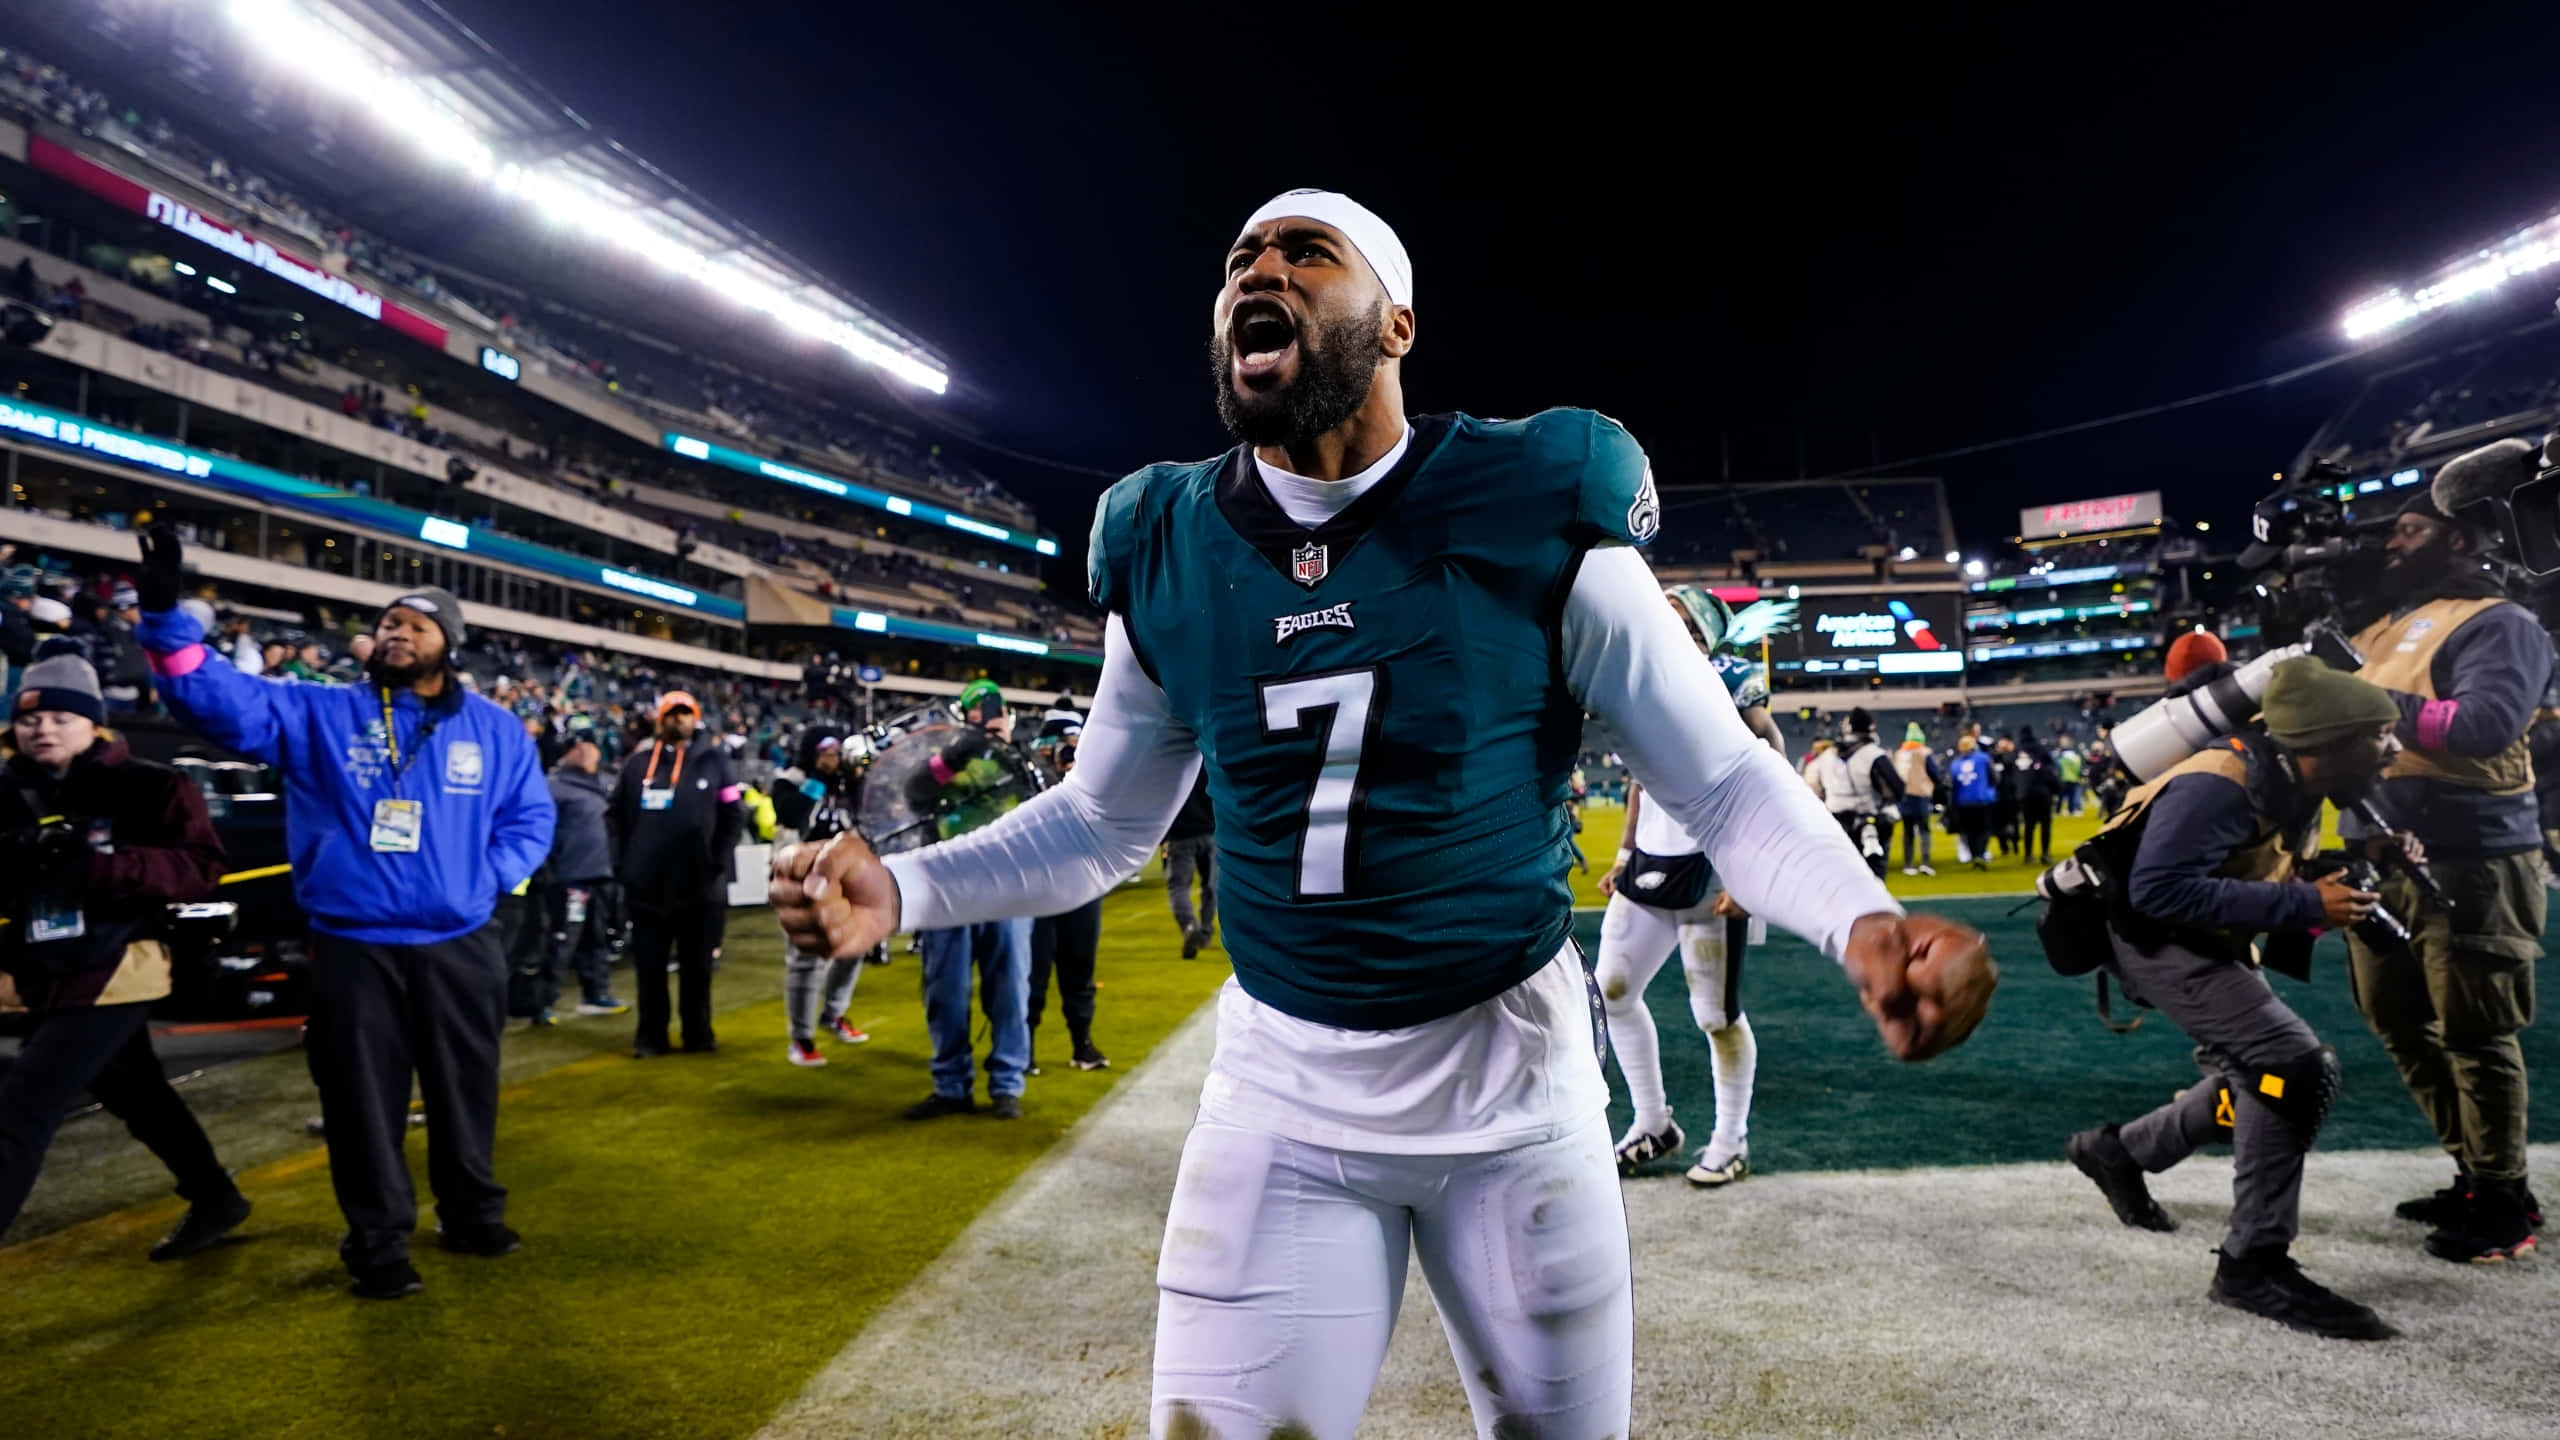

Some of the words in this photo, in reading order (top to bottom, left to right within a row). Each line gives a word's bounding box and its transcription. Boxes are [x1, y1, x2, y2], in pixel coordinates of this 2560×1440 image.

[175, 205, 254, 261] Lincoln
[255, 241, 338, 299] Financial
[338, 280, 381, 319] Field
[1298, 560, 1321, 577] NFL
[1273, 602, 1355, 644] EAGLES
[1816, 612, 1896, 632] American
[1831, 630, 1897, 647] Airlines
[1261, 668, 1376, 897] 7
